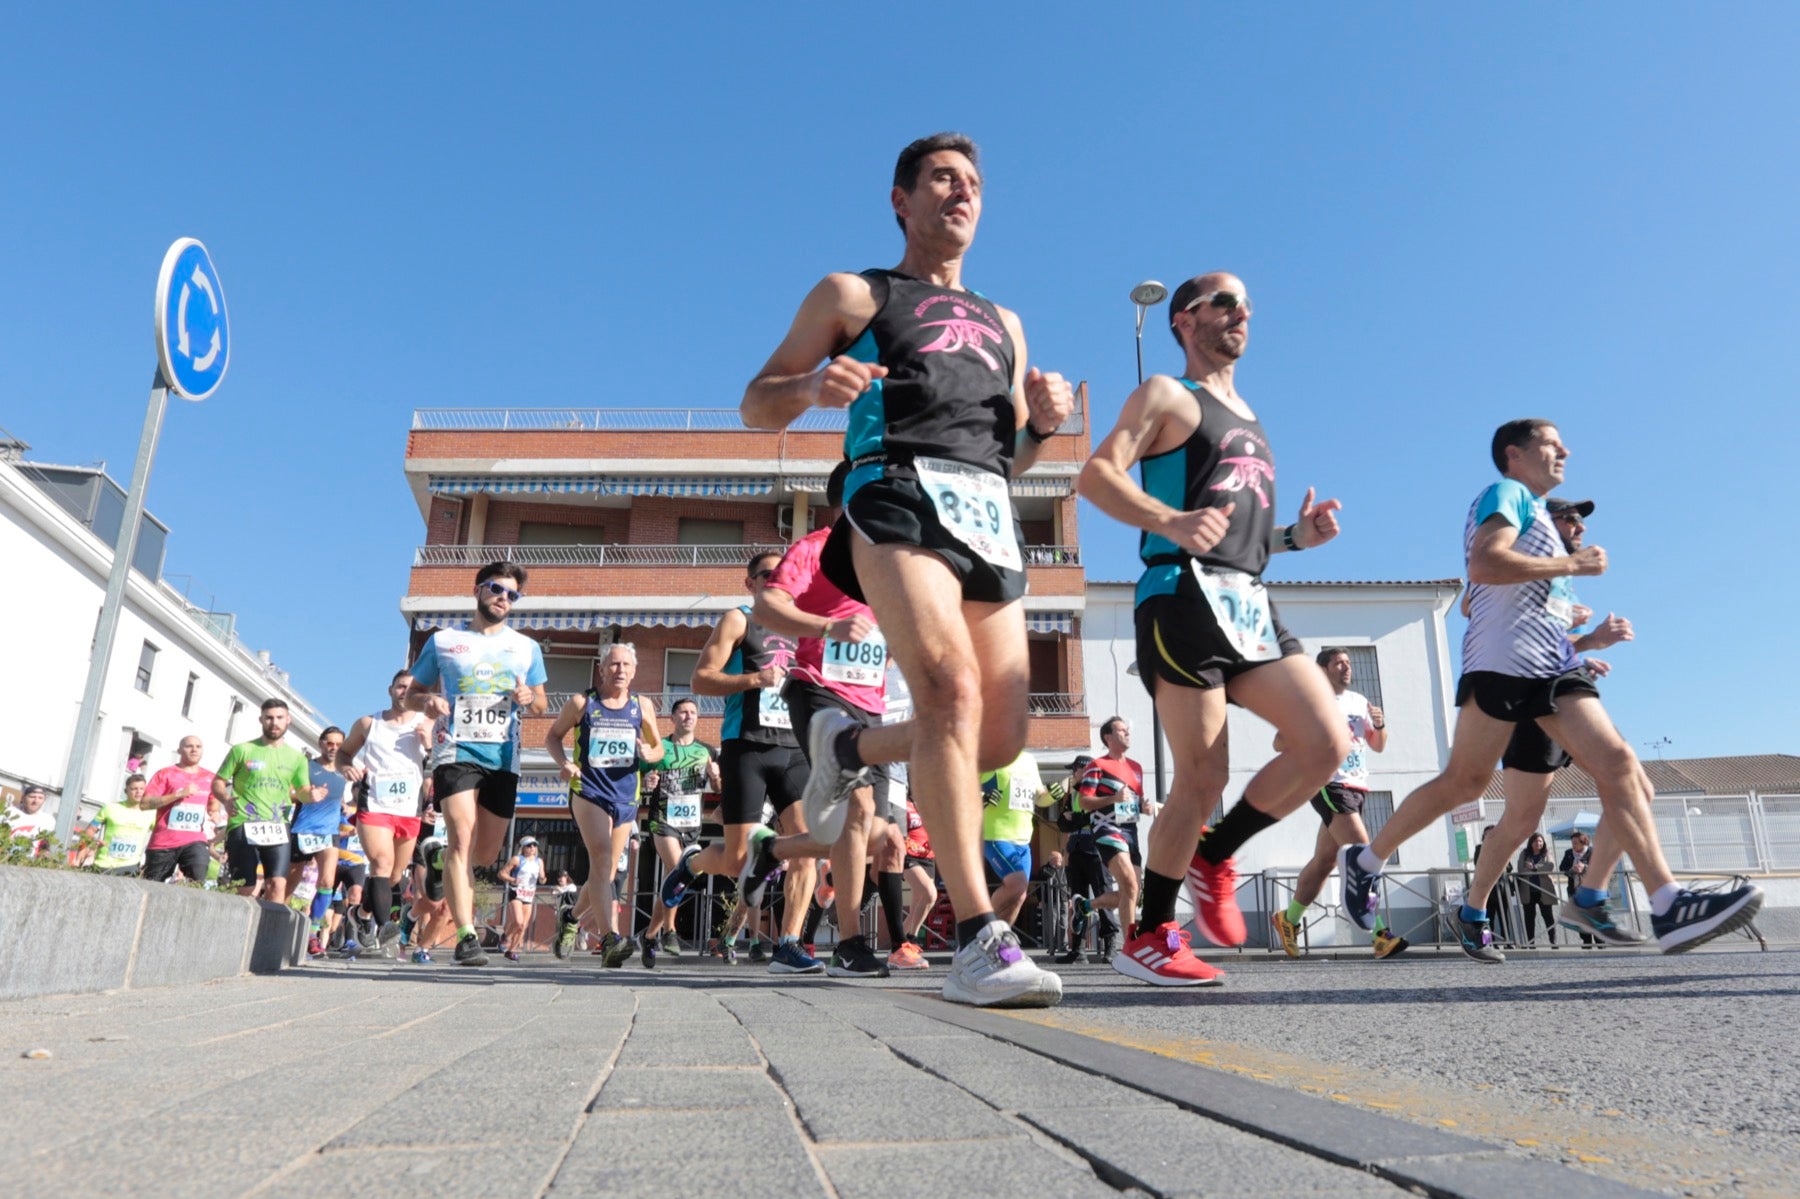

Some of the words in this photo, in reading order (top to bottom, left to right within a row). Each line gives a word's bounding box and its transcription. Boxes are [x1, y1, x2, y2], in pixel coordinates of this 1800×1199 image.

[830, 641, 883, 666] 1089
[462, 708, 507, 726] 3105
[598, 740, 628, 756] 769
[389, 781, 407, 794] 48
[176, 811, 200, 823] 809
[674, 805, 697, 817] 292
[250, 827, 283, 837] 3118
[304, 835, 327, 847] 917
[112, 842, 137, 853] 1070
